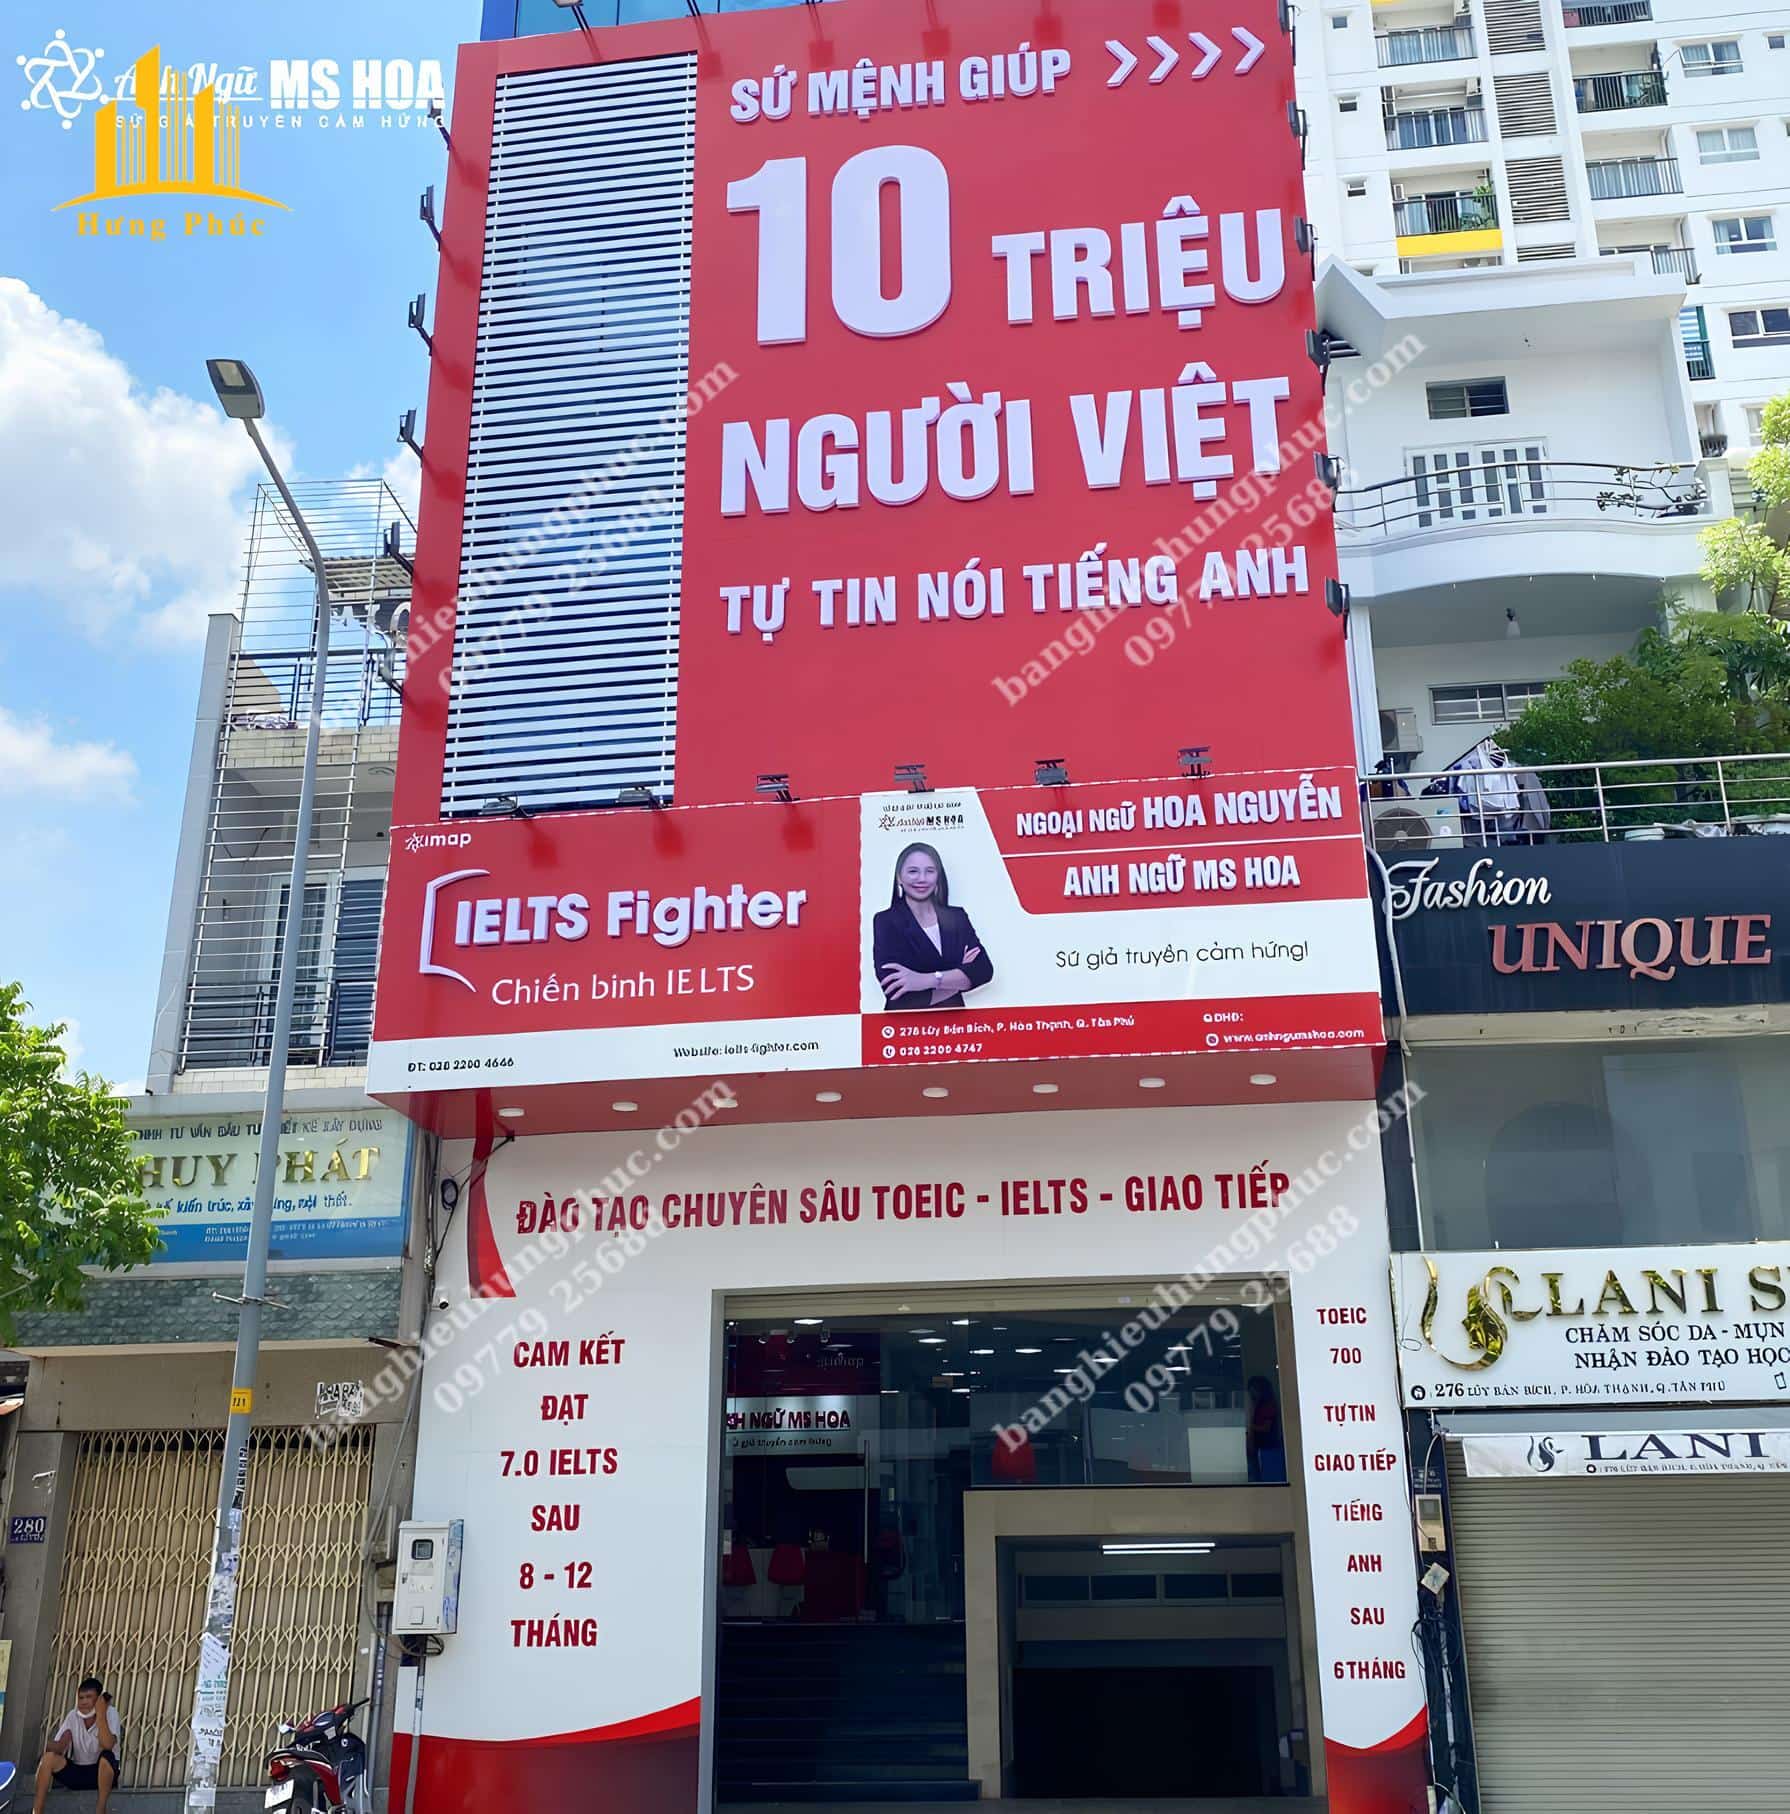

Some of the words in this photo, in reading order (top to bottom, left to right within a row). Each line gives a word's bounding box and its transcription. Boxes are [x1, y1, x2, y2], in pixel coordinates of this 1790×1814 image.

[730, 65, 797, 122] SỨ
[807, 58, 945, 119] MỆNH
[959, 41, 1071, 101] GIÚP
[726, 145, 951, 345] 10
[992, 195, 1285, 330] TRIỆU
[721, 382, 1034, 516] NGƯỜI
[1070, 361, 1291, 500] VIỆT
[720, 577, 790, 644] TỰ
[812, 575, 896, 628] TIN
[918, 558, 1004, 622] NÓI
[1023, 541, 1178, 613] TIẾNG
[1200, 546, 1309, 602] ANH
[1016, 810, 1083, 838] NGOẠI
[1089, 801, 1136, 832] NGỮ
[1144, 794, 1207, 830] HOA
[1214, 774, 1342, 826] NGUYỄN
[1064, 864, 1120, 897] ANH
[1129, 853, 1186, 894] NGỮ
[1193, 858, 1236, 891] MS
[1244, 855, 1301, 888] HOA
[1384, 856, 1551, 919] Fashion
[455, 892, 588, 947] IELTS
[608, 883, 807, 948] Fighter
[1056, 951, 1080, 968] Sứ
[1086, 946, 1118, 971] giả
[1196, 941, 1244, 962] cảm
[1487, 914, 1773, 981] UNIQUE
[491, 974, 580, 1006] Chiến
[591, 970, 656, 1000] binh
[667, 964, 755, 995] IELTS
[516, 1192, 579, 1234] ĐÀO
[593, 1194, 649, 1238] TẠO
[662, 1182, 788, 1229] CHUYÊN
[800, 1180, 861, 1223] SÂU
[872, 1183, 965, 1220] TOEIC
[1001, 1178, 1088, 1216] IELTS
[1125, 1174, 1202, 1211] GIAO
[1214, 1159, 1290, 1208] TIẾP
[1541, 1268, 1726, 1316] LANI
[1748, 1265, 1790, 1312] S
[1317, 1308, 1368, 1325] TOEIC
[1638, 1321, 1680, 1341] SÓC
[1688, 1324, 1717, 1341] DA
[1733, 1322, 1785, 1342] MỤN
[513, 1341, 569, 1368] CAM
[580, 1331, 626, 1365] KẾT
[1330, 1348, 1362, 1364] 700
[1575, 1351, 1637, 1371] NHẬN
[1646, 1347, 1689, 1366] ĐÀO
[1698, 1348, 1739, 1368] TẠO
[1435, 1384, 1465, 1397] 276
[541, 1394, 589, 1426] ĐẠT
[500, 1450, 539, 1477] 7.0
[549, 1448, 618, 1475] IELTS
[1314, 1454, 1355, 1471] GIAO
[1359, 1448, 1397, 1471] TIẾP
[1581, 1433, 1770, 1461] LANI
[13, 1518, 44, 1534] 280
[531, 1505, 580, 1531] SAU
[519, 1563, 534, 1589] 8
[564, 1562, 592, 1588] 12
[1347, 1555, 1382, 1572] ANH
[510, 1613, 597, 1647] THÁNG
[1350, 1607, 1385, 1625] SAU
